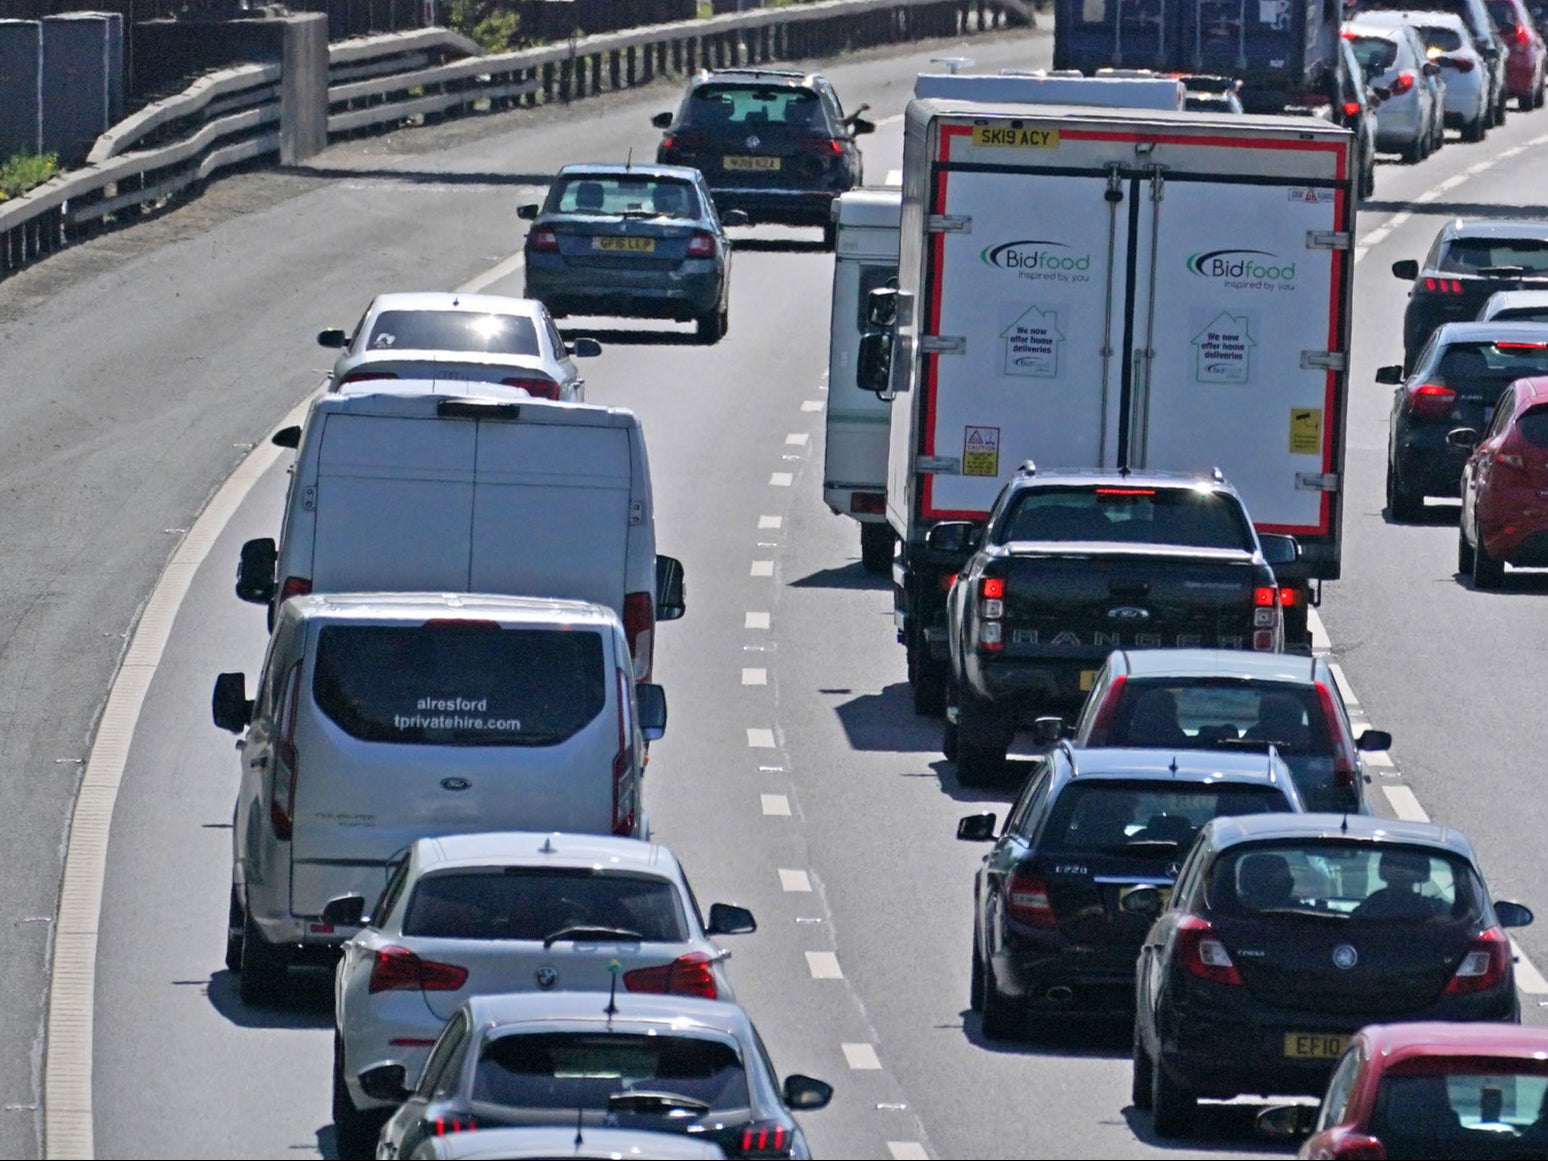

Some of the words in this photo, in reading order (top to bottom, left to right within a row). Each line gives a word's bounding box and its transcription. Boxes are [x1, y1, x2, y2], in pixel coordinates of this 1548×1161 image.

[982, 129, 1016, 145] SK19
[1020, 131, 1050, 146] ACY
[1007, 250, 1090, 270] Bidfood
[1212, 259, 1296, 280] Bidfood
[1019, 271, 1056, 281] inspired
[1058, 272, 1068, 282] by
[1072, 274, 1089, 283] you
[1224, 280, 1262, 290] inspired
[1263, 281, 1274, 291] by
[1278, 283, 1295, 291] you
[1030, 336, 1053, 344] home
[1013, 345, 1052, 354] deliveries
[1205, 351, 1243, 360] deliveries
[417, 697, 487, 711] alresford
[394, 714, 520, 730] tprivatehire.com
[1297, 1037, 1340, 1055] EF10
